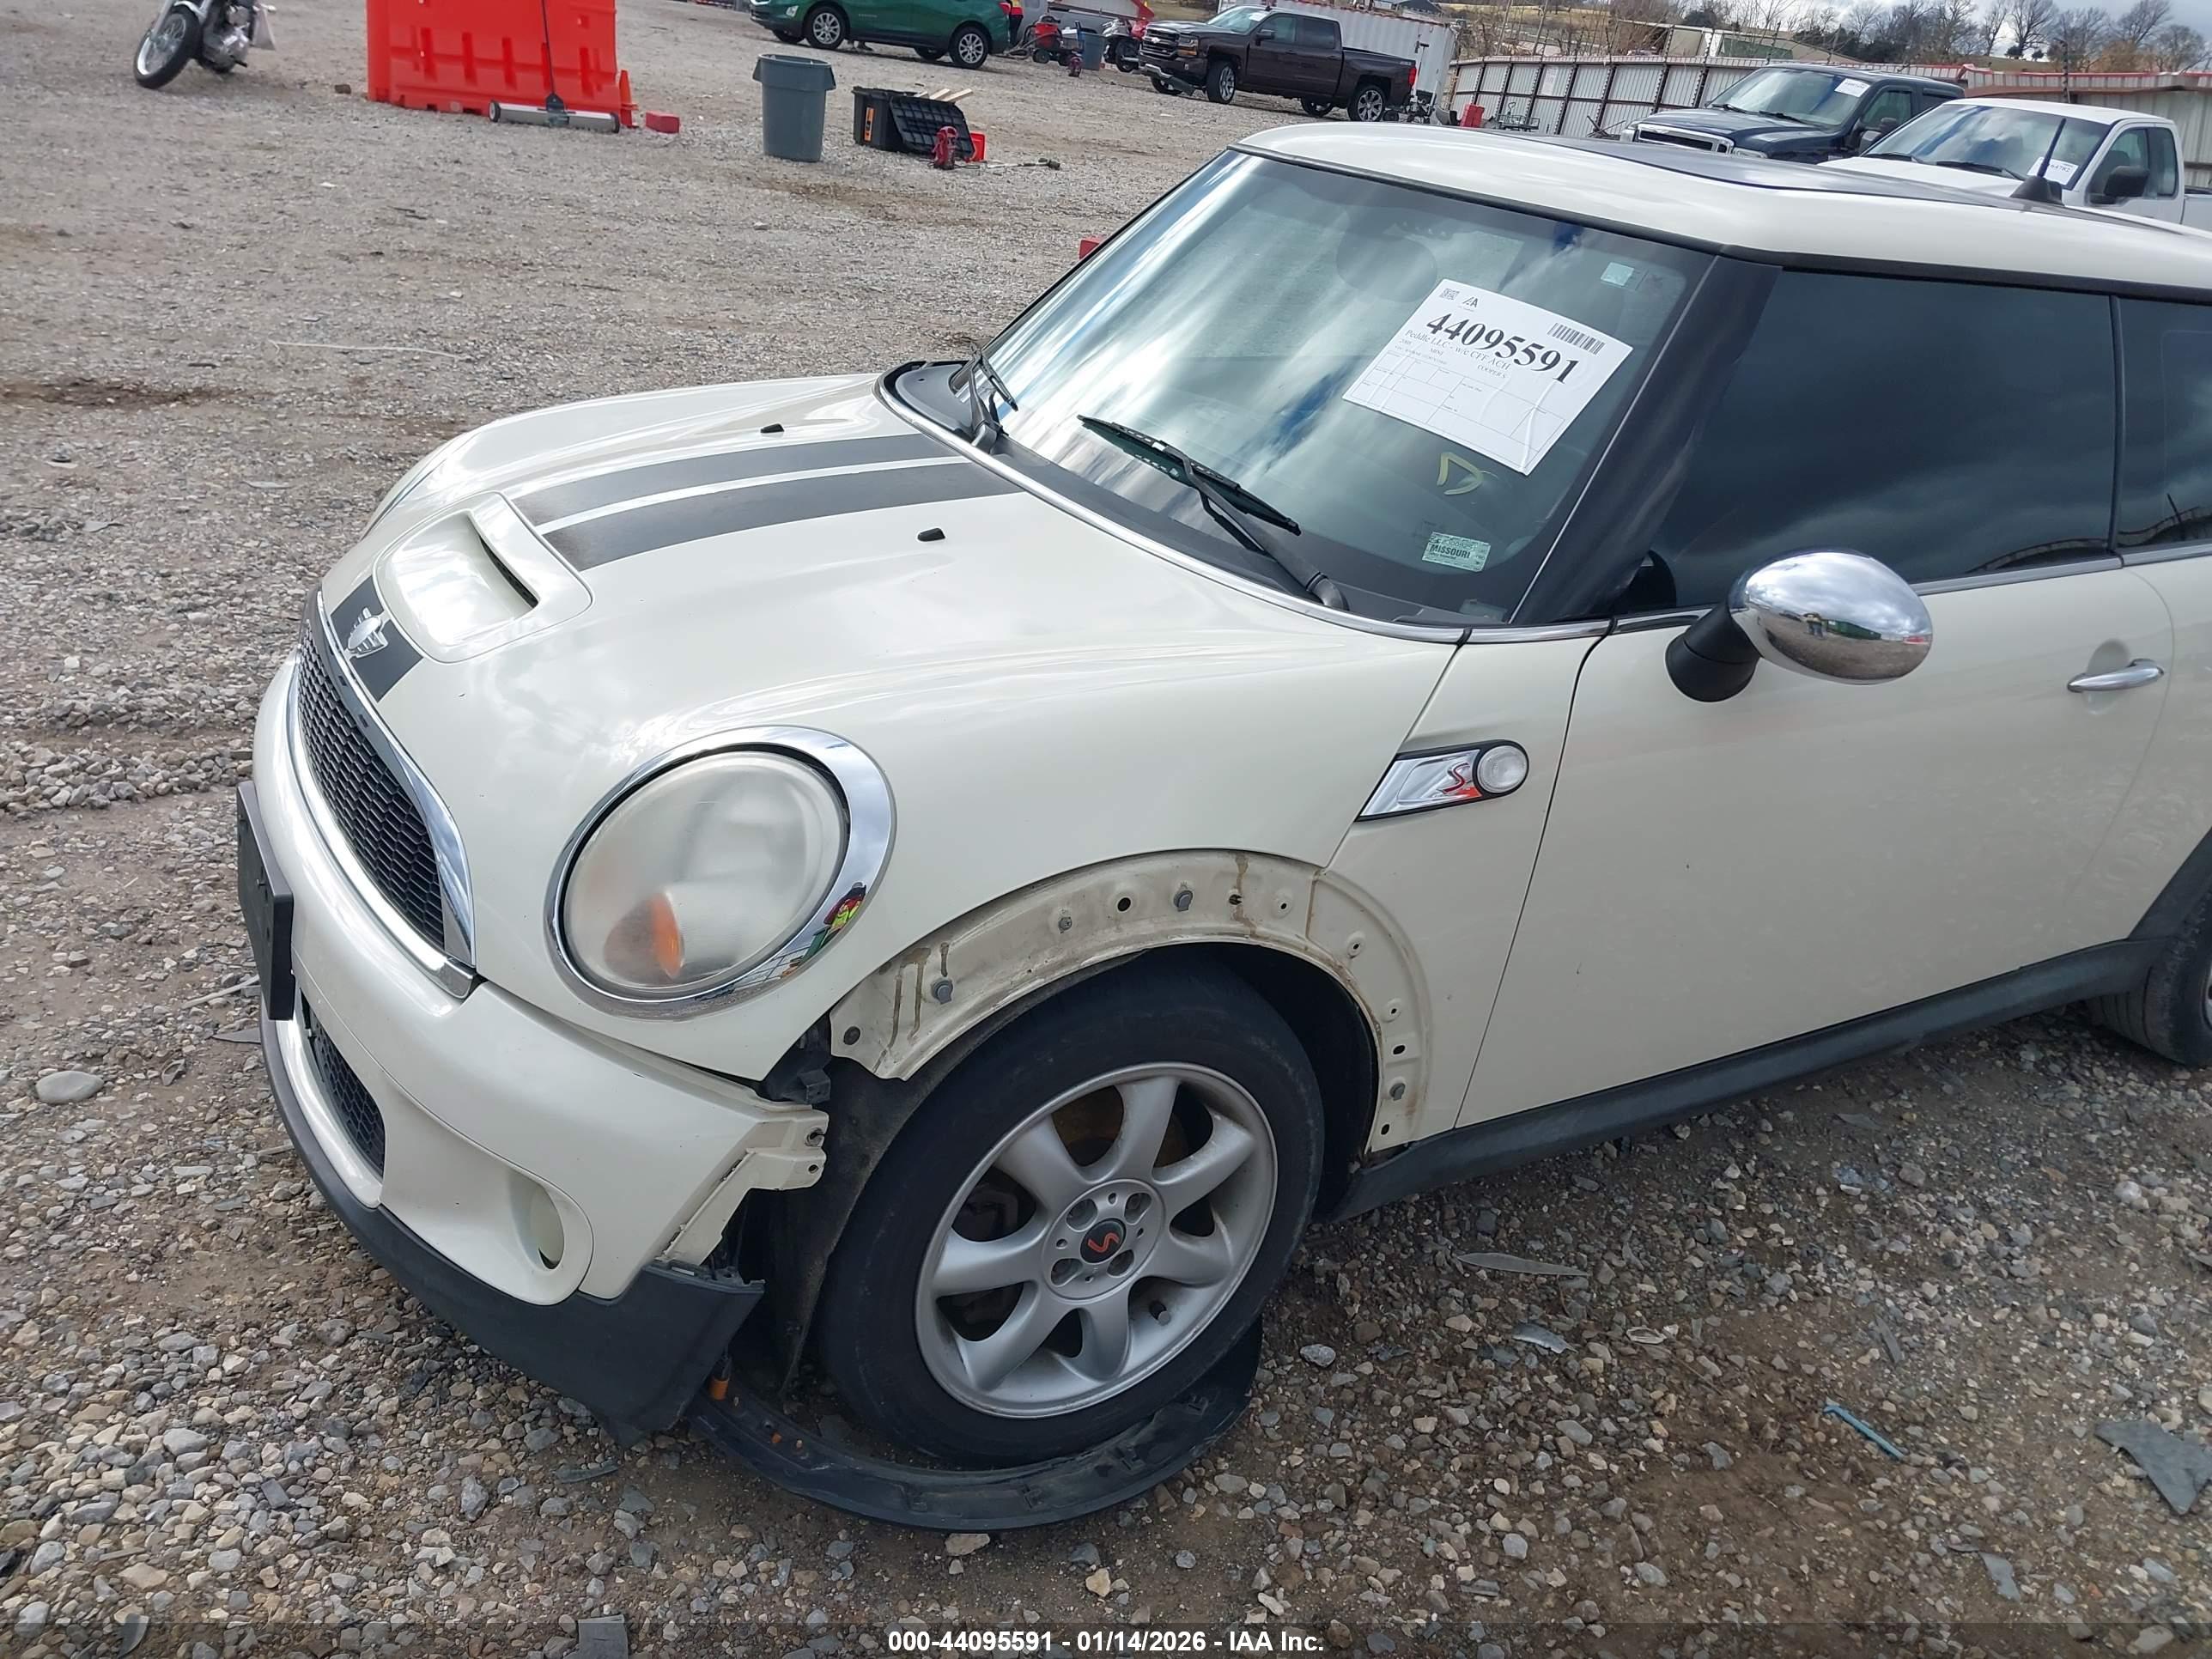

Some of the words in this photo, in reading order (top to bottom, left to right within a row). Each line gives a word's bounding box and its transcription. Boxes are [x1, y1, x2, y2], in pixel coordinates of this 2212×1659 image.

[1405, 329, 1431, 343] Peddle
[1425, 313, 1580, 385] 44095591
[1429, 544, 1471, 559] MISSOURI
